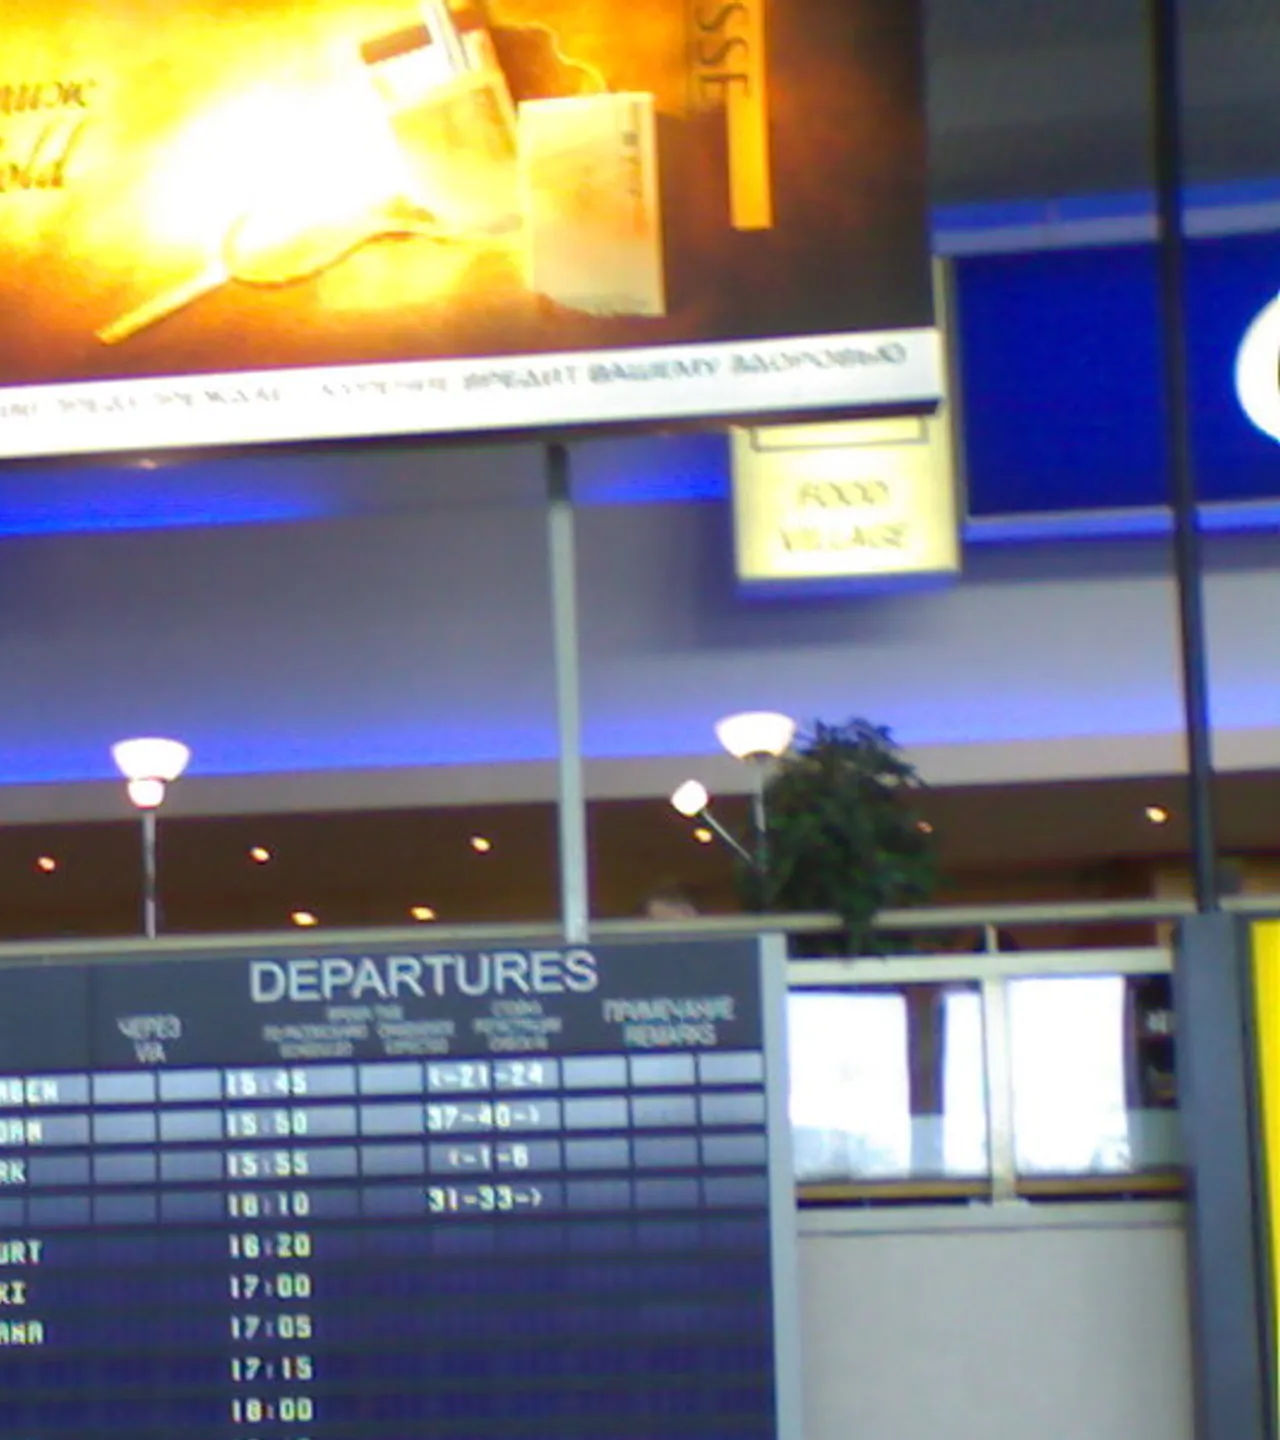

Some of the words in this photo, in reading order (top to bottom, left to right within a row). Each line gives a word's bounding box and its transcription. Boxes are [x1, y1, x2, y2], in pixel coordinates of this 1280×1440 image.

[249, 951, 598, 1001] DEPARTURES
[229, 1272, 311, 1299] 17:00
[231, 1315, 312, 1339] 17:05
[232, 1356, 313, 1381] 17:15
